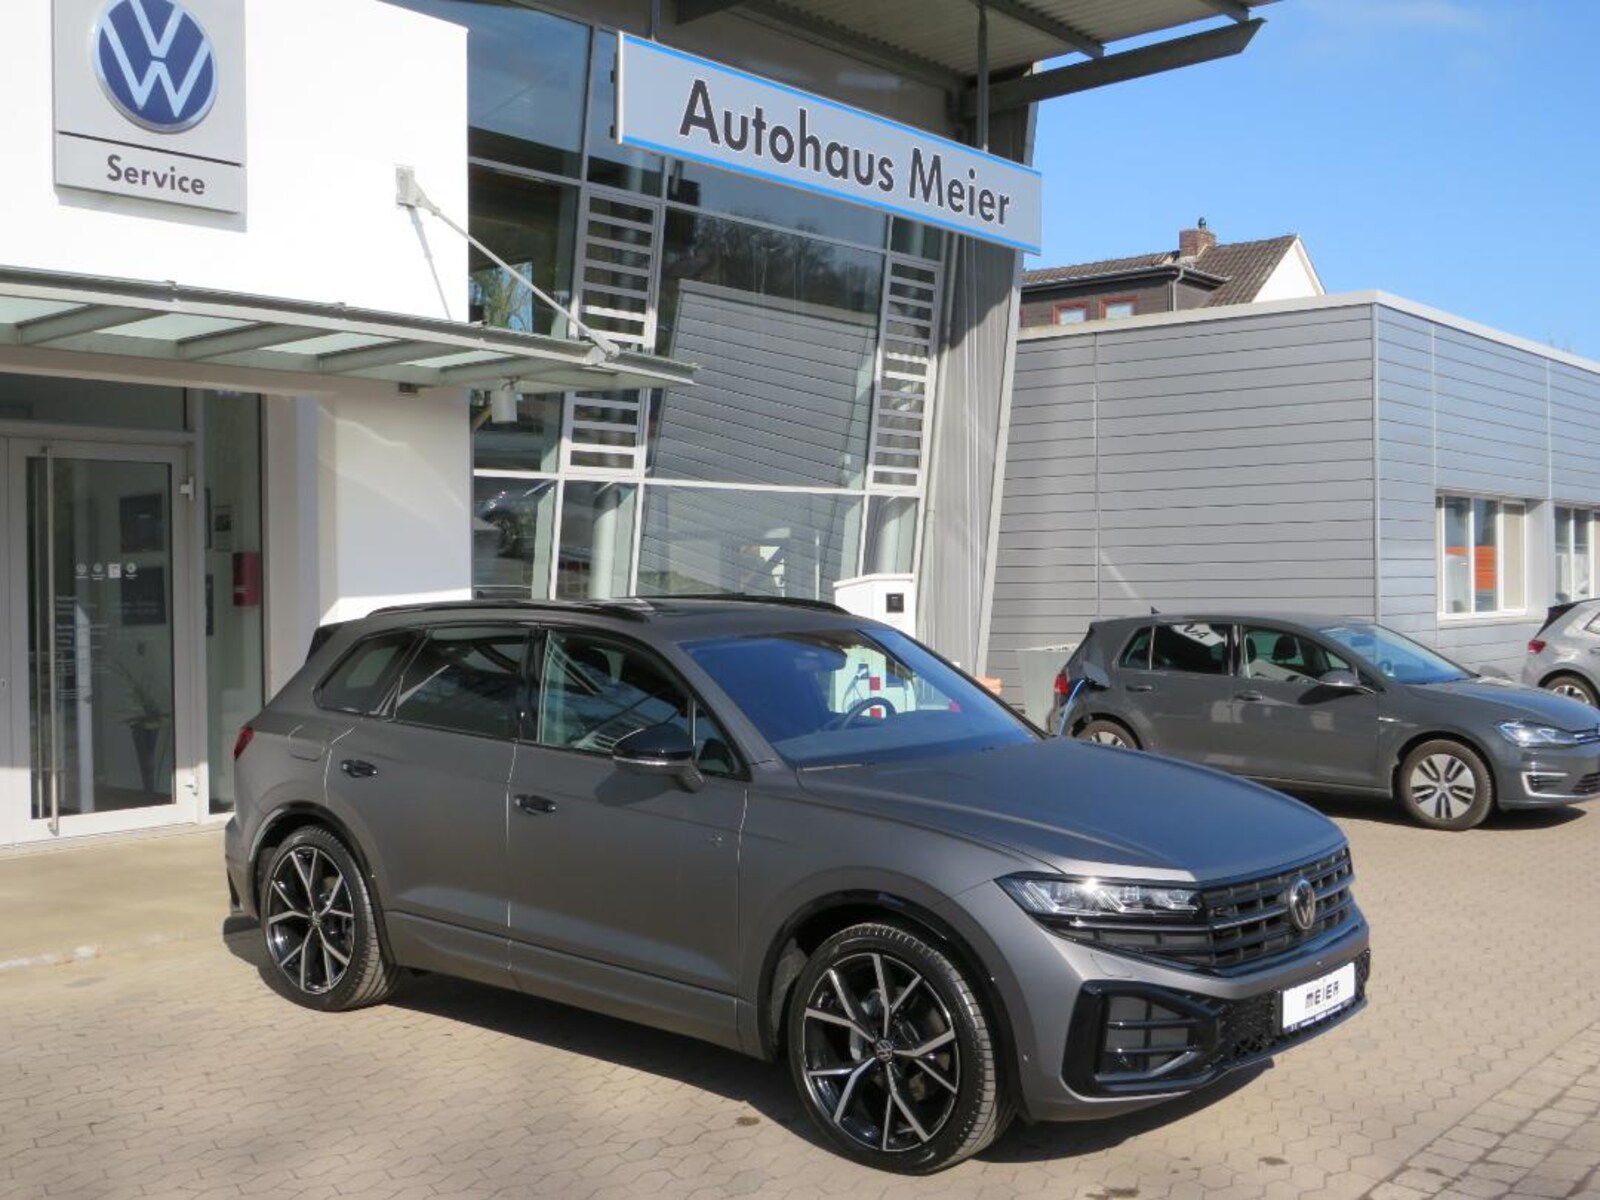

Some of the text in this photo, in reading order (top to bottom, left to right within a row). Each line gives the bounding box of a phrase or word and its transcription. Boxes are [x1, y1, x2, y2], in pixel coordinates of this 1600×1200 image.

[680, 78, 1010, 225] Autohaus Meier
[106, 153, 206, 195] Service
[1305, 980, 1339, 1009] MEIER
